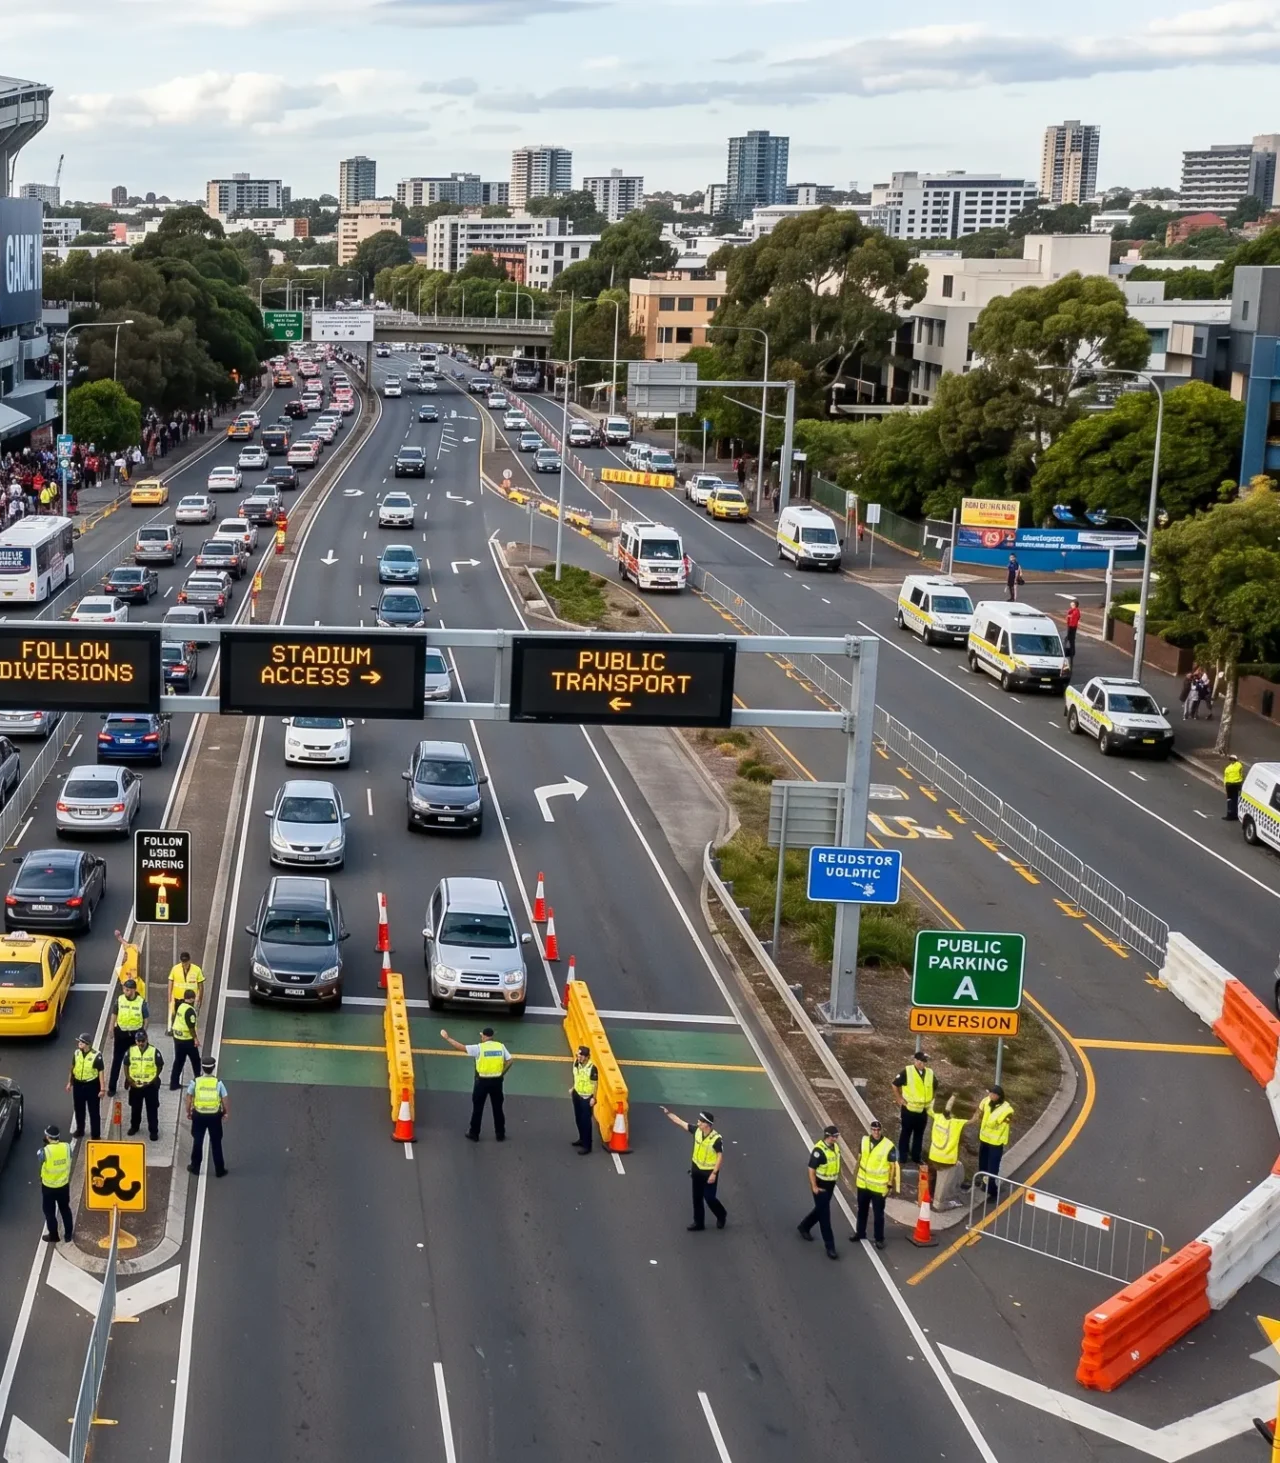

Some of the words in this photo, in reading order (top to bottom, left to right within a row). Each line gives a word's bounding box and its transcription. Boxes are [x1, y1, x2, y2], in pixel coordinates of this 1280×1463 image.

[21, 640, 110, 661] FOLLOW
[271, 645, 372, 665] STADIUM
[579, 651, 666, 671] PUBLIC
[261, 667, 350, 686] ACCESS
[551, 672, 692, 694] TRANSPORT
[937, 938, 1002, 954] PUBLIC
[928, 955, 1009, 972] PARKING
[952, 975, 979, 1000] A
[916, 1013, 1011, 1030] DIVERSION
